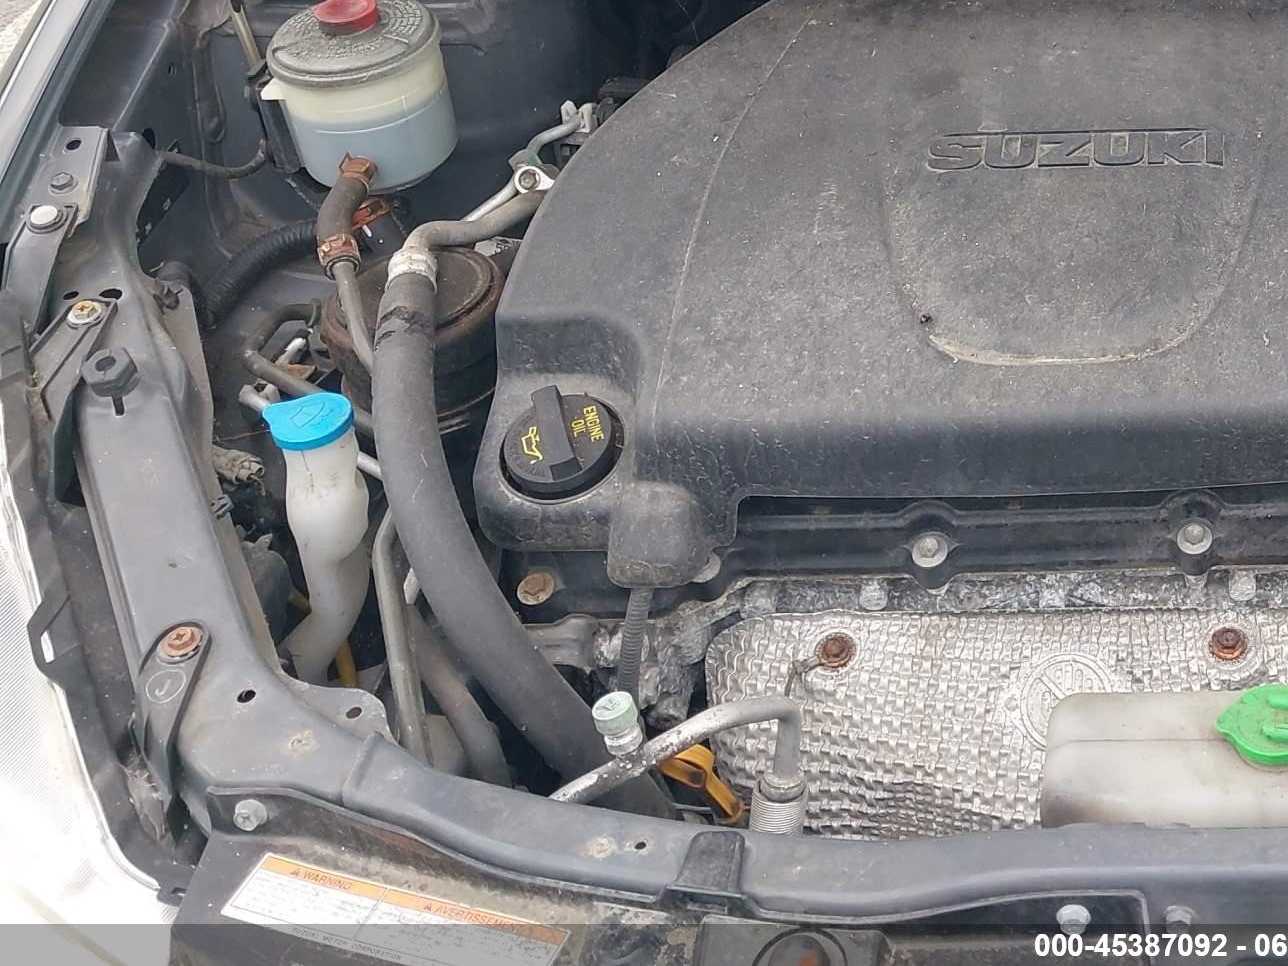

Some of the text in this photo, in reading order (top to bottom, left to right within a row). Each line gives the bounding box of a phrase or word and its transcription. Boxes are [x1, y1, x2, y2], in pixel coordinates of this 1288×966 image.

[926, 128, 1224, 173] SUZUKI
[571, 419, 586, 437] OIL
[583, 405, 605, 442] ENGINE
[302, 870, 353, 892] WARNING
